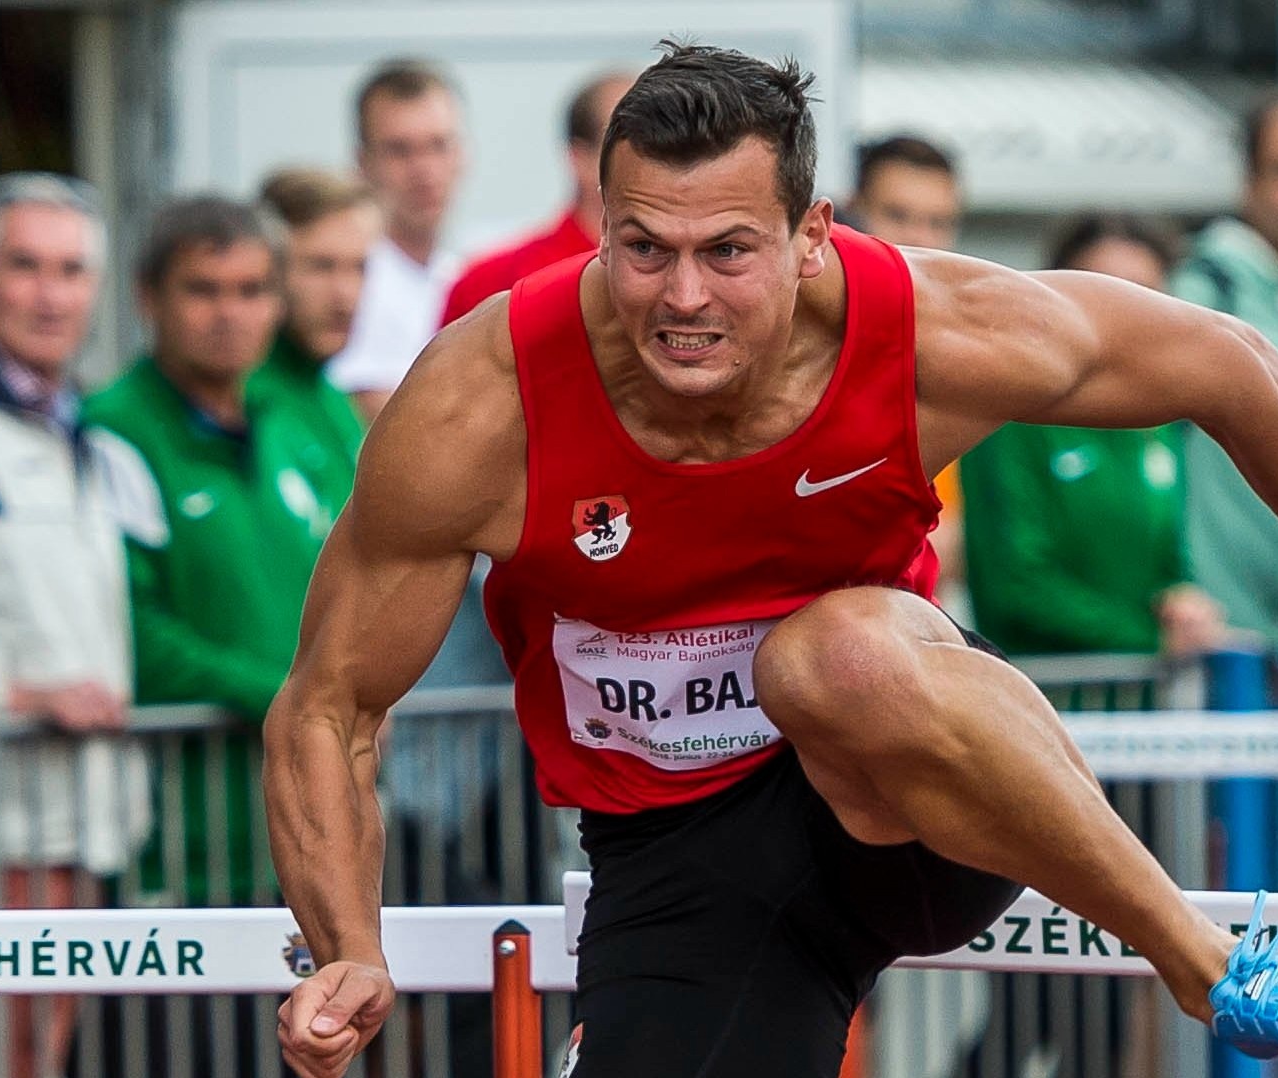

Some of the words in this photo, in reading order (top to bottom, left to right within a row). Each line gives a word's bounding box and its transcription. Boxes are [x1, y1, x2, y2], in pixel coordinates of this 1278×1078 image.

[614, 632, 658, 645] 123.
[616, 646, 673, 662] Magyar
[678, 641, 755, 663] Bajnokság
[595, 677, 672, 722] DR.
[616, 726, 771, 753] Székesfehérvár
